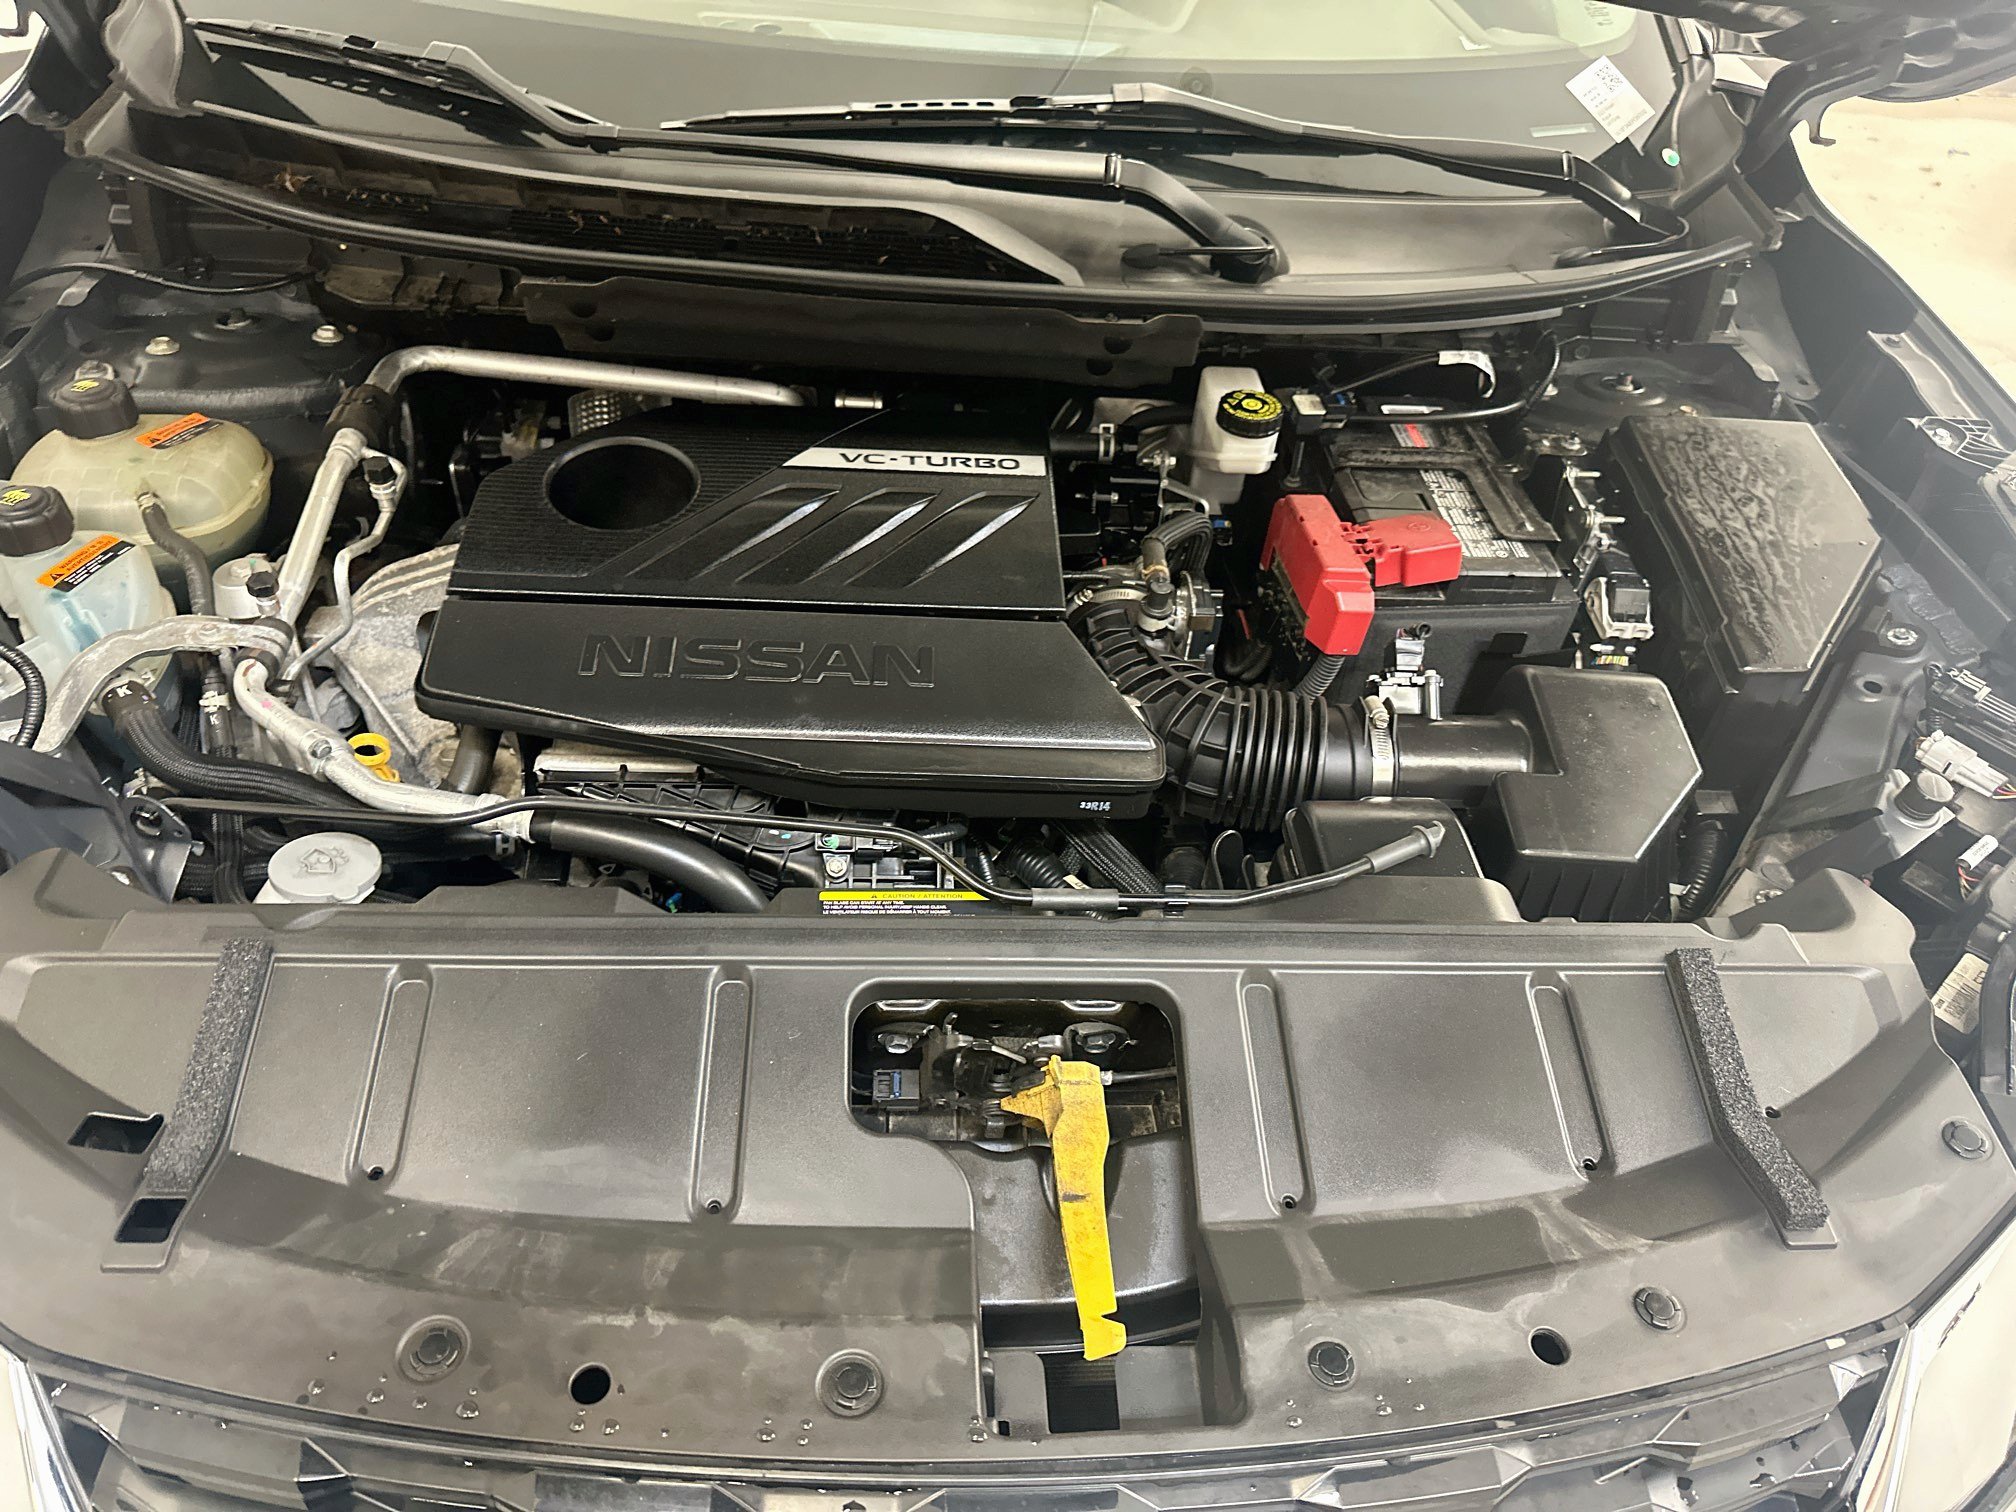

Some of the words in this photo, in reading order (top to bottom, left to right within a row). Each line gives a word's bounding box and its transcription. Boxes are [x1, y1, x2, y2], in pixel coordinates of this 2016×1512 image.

[838, 450, 1022, 471] VC-TURBO
[576, 634, 936, 689] NISSAN
[1079, 801, 1111, 812] 33R14
